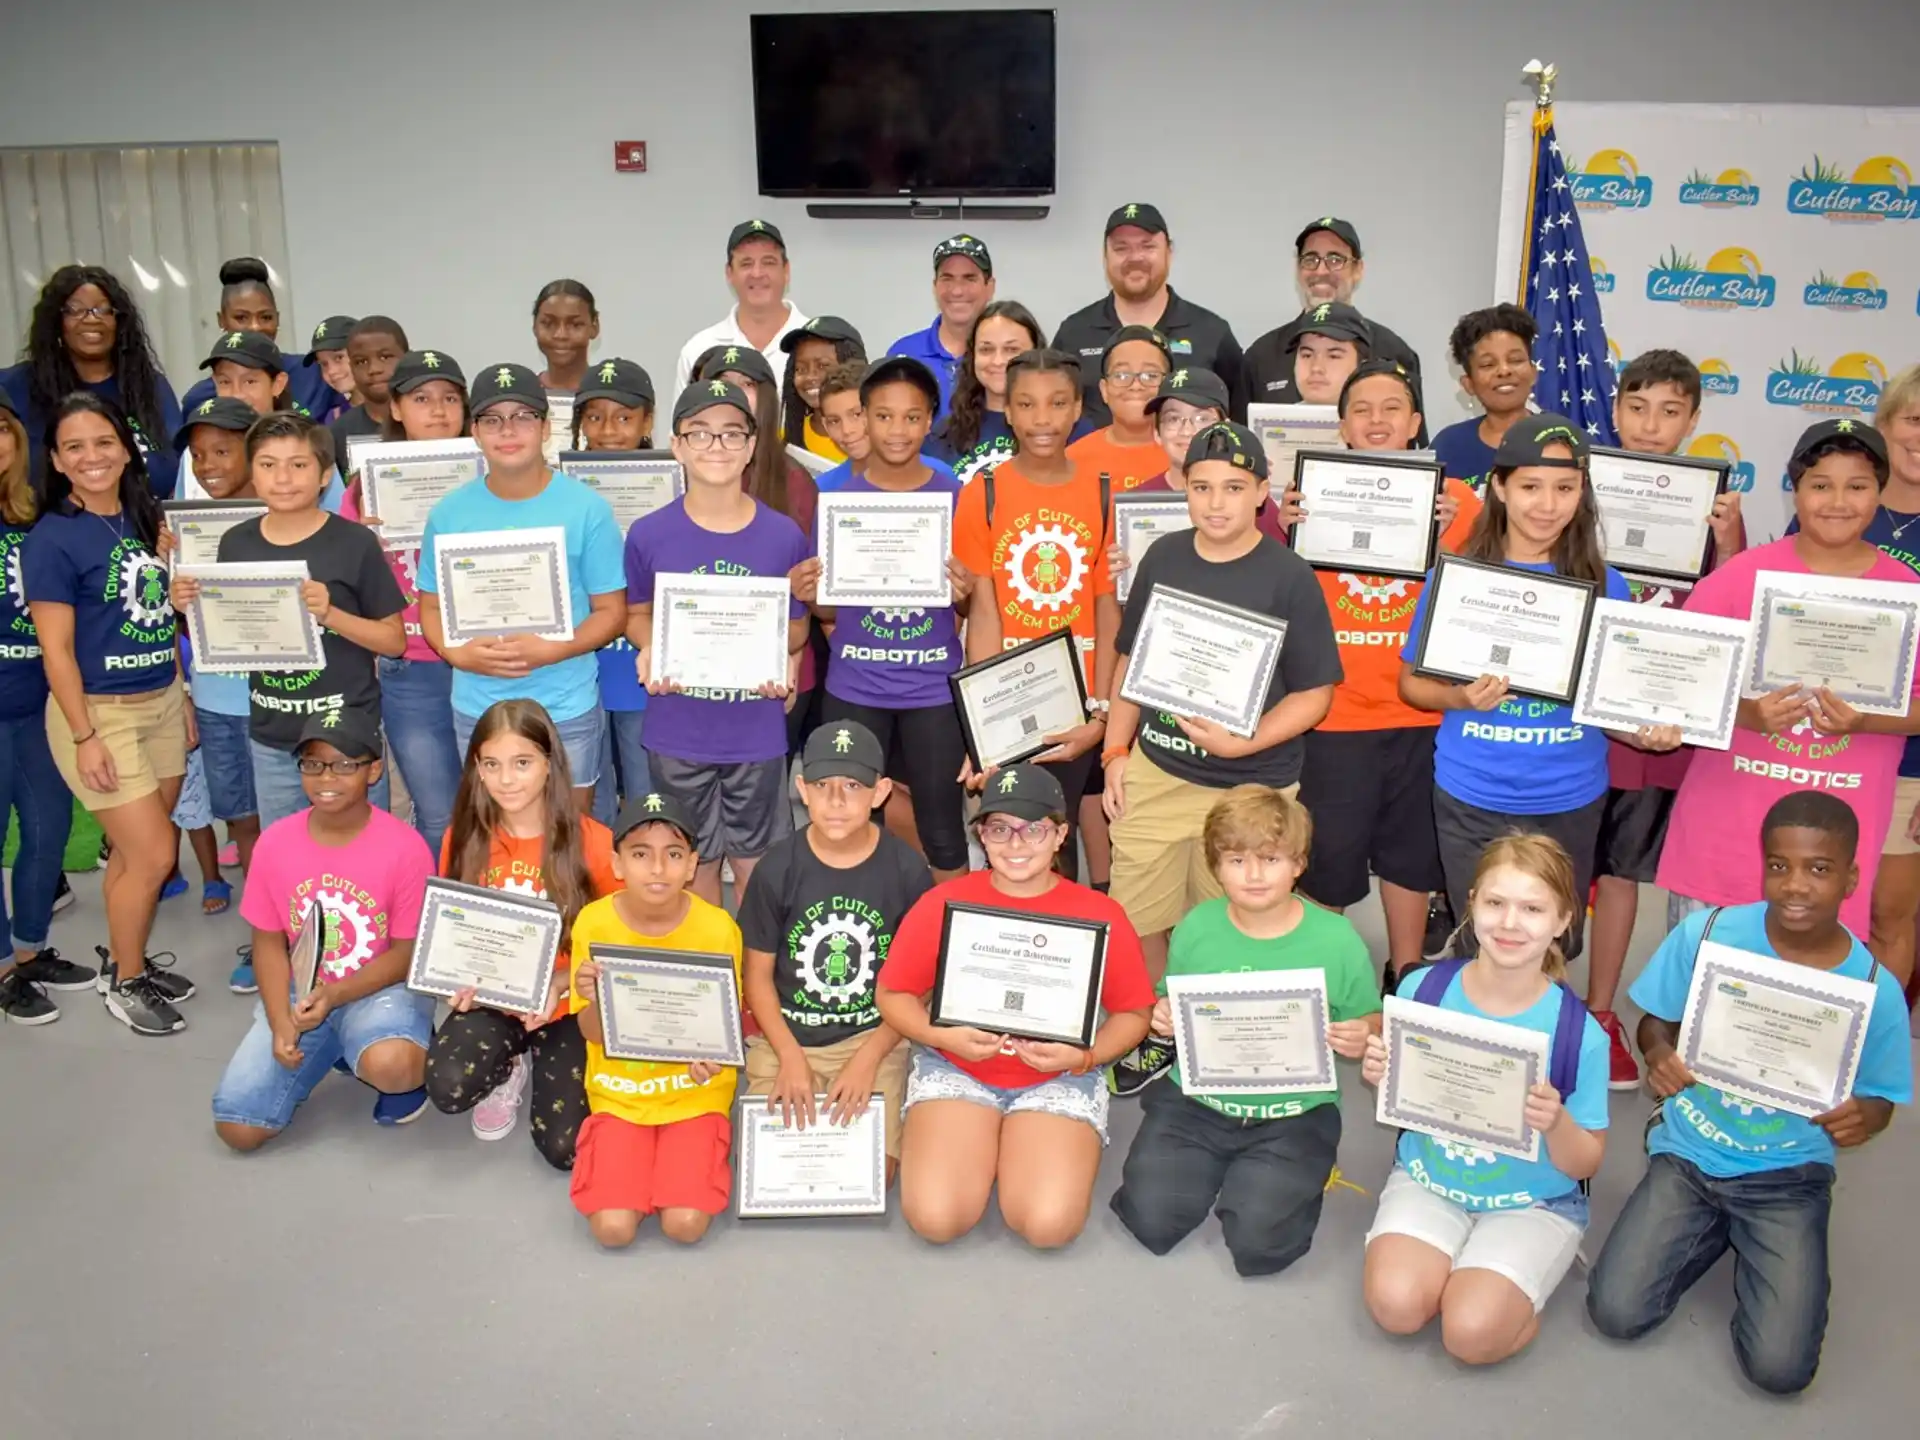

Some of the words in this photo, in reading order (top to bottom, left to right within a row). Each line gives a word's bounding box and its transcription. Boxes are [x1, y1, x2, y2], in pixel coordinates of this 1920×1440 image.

[1600, 181, 1645, 212] Bay
[1682, 186, 1723, 201] Cutler
[1726, 189, 1755, 206] Bay
[1794, 185, 1862, 210] Cutler
[1868, 190, 1918, 223] Bay
[1652, 274, 1716, 298] Cutler
[1722, 279, 1769, 310] Bay
[1807, 287, 1849, 303] Cutler
[1852, 291, 1883, 309] Bay
[1706, 377, 1735, 394] Bay
[1772, 379, 1838, 403] Cutler
[1845, 385, 1878, 406] Ba
[110, 546, 124, 562] OF
[991, 528, 1015, 572] TOWN
[1014, 512, 1032, 530] OF
[1037, 508, 1092, 541] CUTLER
[104, 563, 121, 602] TOWN
[1004, 600, 1043, 629] STEM
[1048, 605, 1082, 630] CAMP
[1335, 595, 1373, 623] STEM
[1379, 597, 1417, 623] CAMP
[11, 616, 37, 636] STE
[120, 621, 155, 644] STEM
[860, 615, 894, 641] STEM
[899, 617, 934, 641] CAMP
[840, 643, 949, 667] ROBOTICS
[1462, 720, 1585, 745] ROBOTICS
[1765, 732, 1802, 757] TEM
[1808, 734, 1852, 760] CAMP
[1733, 755, 1864, 789] ROBOTICS
[296, 877, 314, 897] OF
[322, 873, 377, 910] CUTLER
[805, 900, 825, 921] OF
[832, 895, 885, 931] CUTLER
[971, 942, 1011, 956] Certificate
[1408, 1158, 1534, 1209] ROBOTICS
